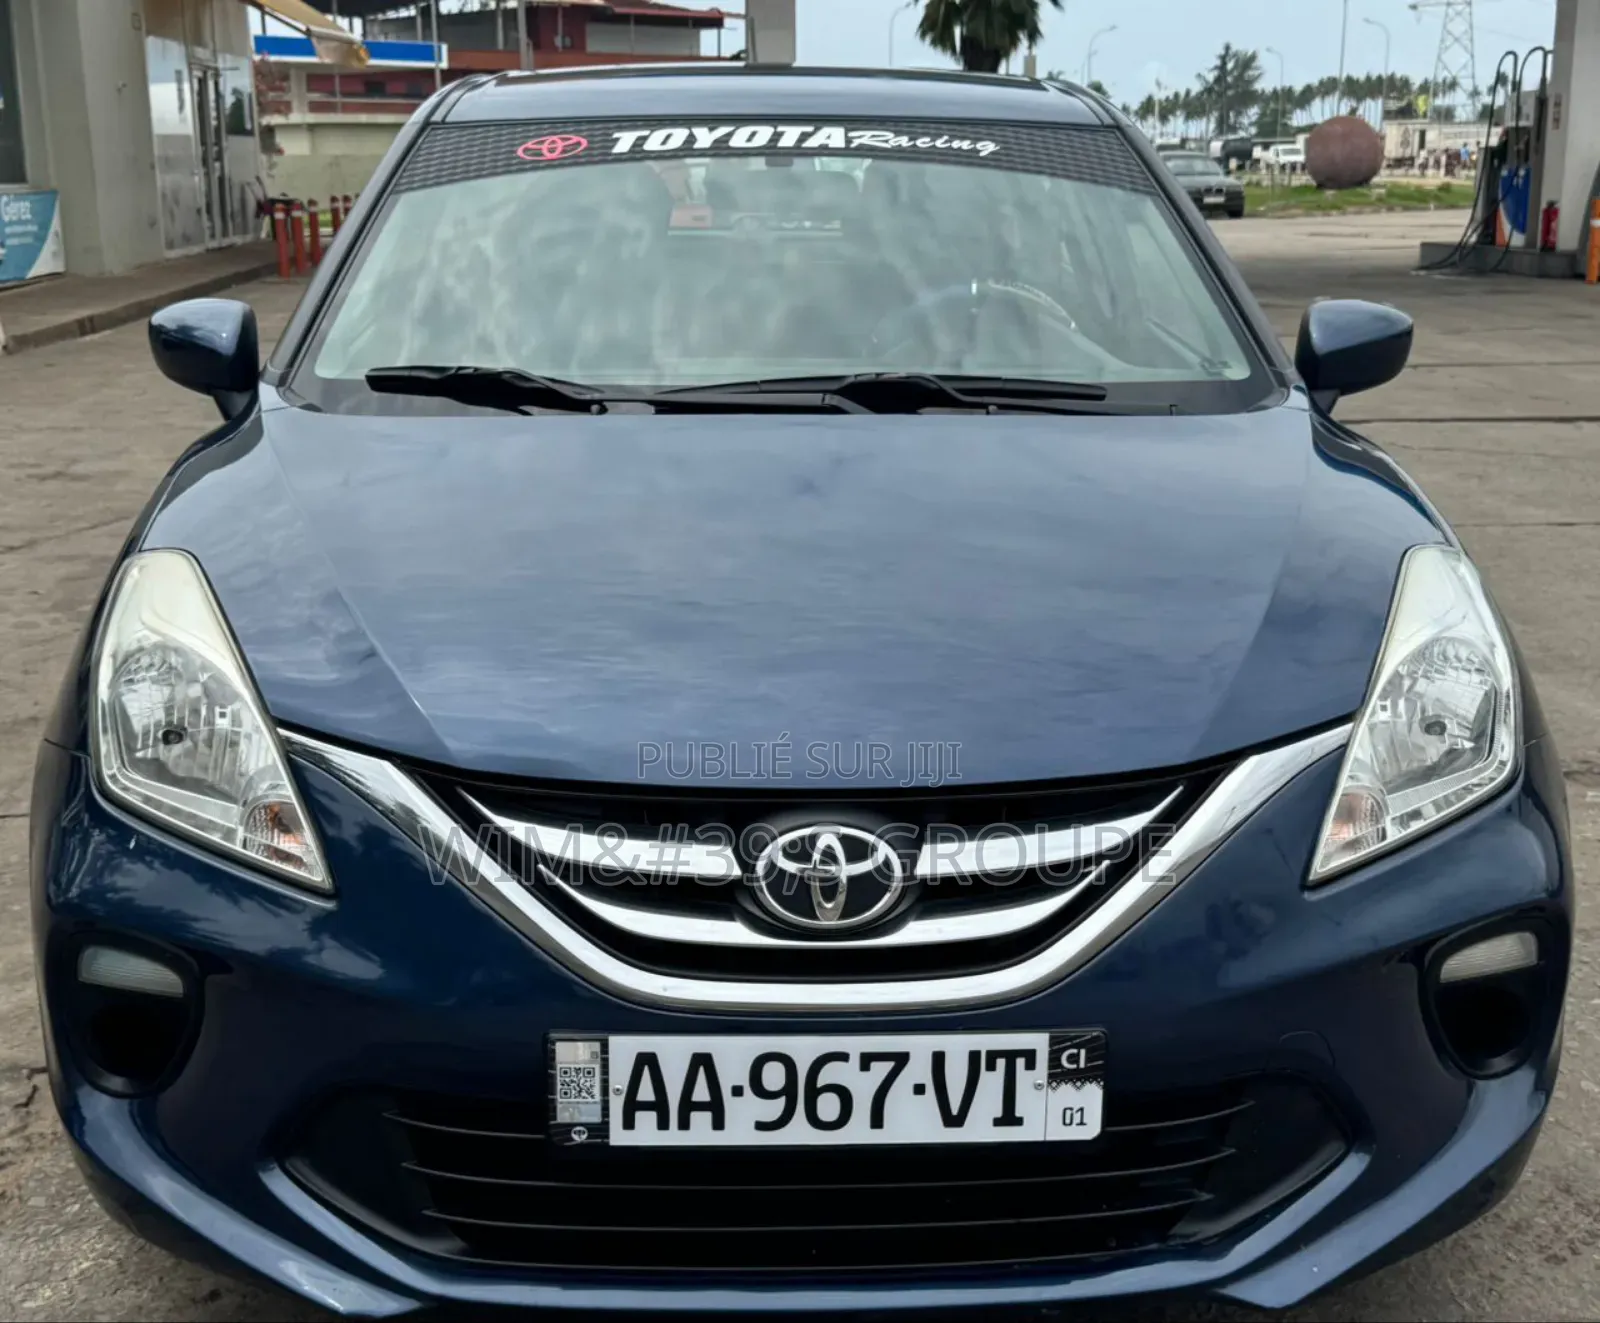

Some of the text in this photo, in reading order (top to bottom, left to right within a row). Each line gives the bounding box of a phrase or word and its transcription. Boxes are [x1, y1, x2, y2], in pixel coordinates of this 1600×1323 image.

[610, 125, 1000, 157] TOYOTA Racing
[1060, 1048, 1086, 1069] CI
[1062, 1106, 1087, 1126] 01
